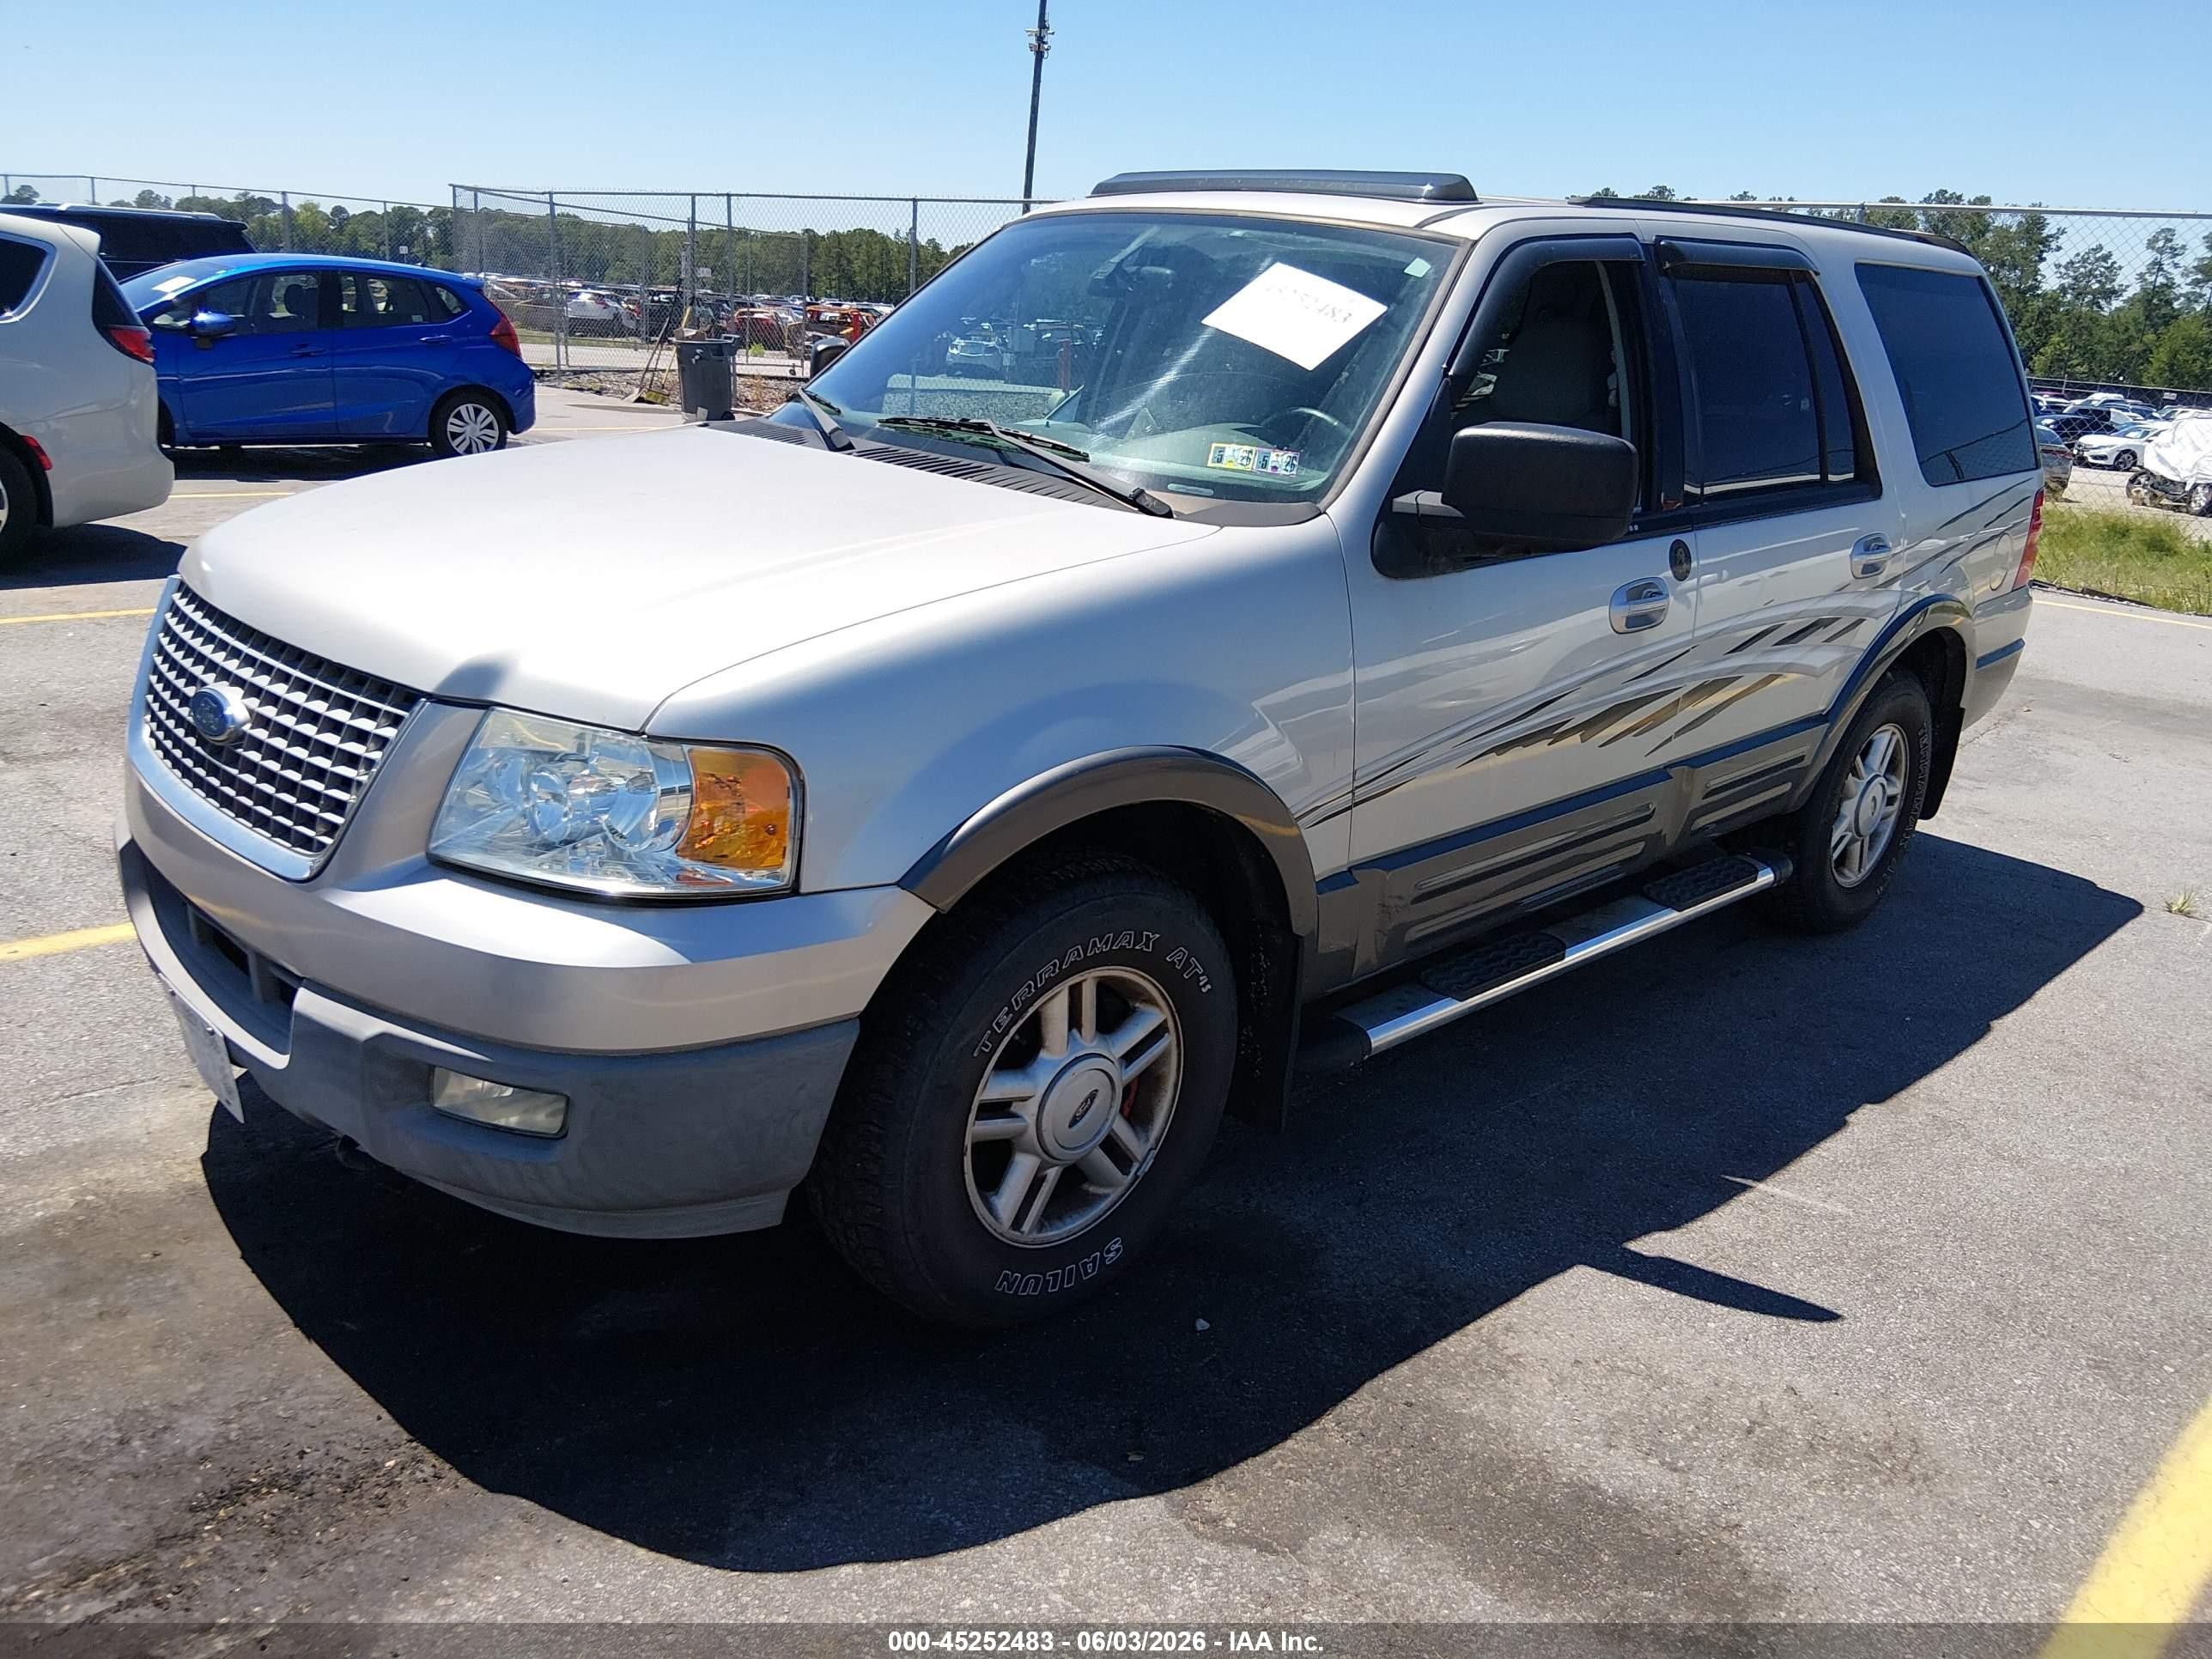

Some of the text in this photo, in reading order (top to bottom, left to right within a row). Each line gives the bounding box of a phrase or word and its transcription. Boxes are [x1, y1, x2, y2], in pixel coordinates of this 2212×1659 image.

[1285, 455, 1298, 472] 26
[974, 931, 1160, 1058] TERRAMAX
[995, 1237, 1123, 1296] SAILUN
